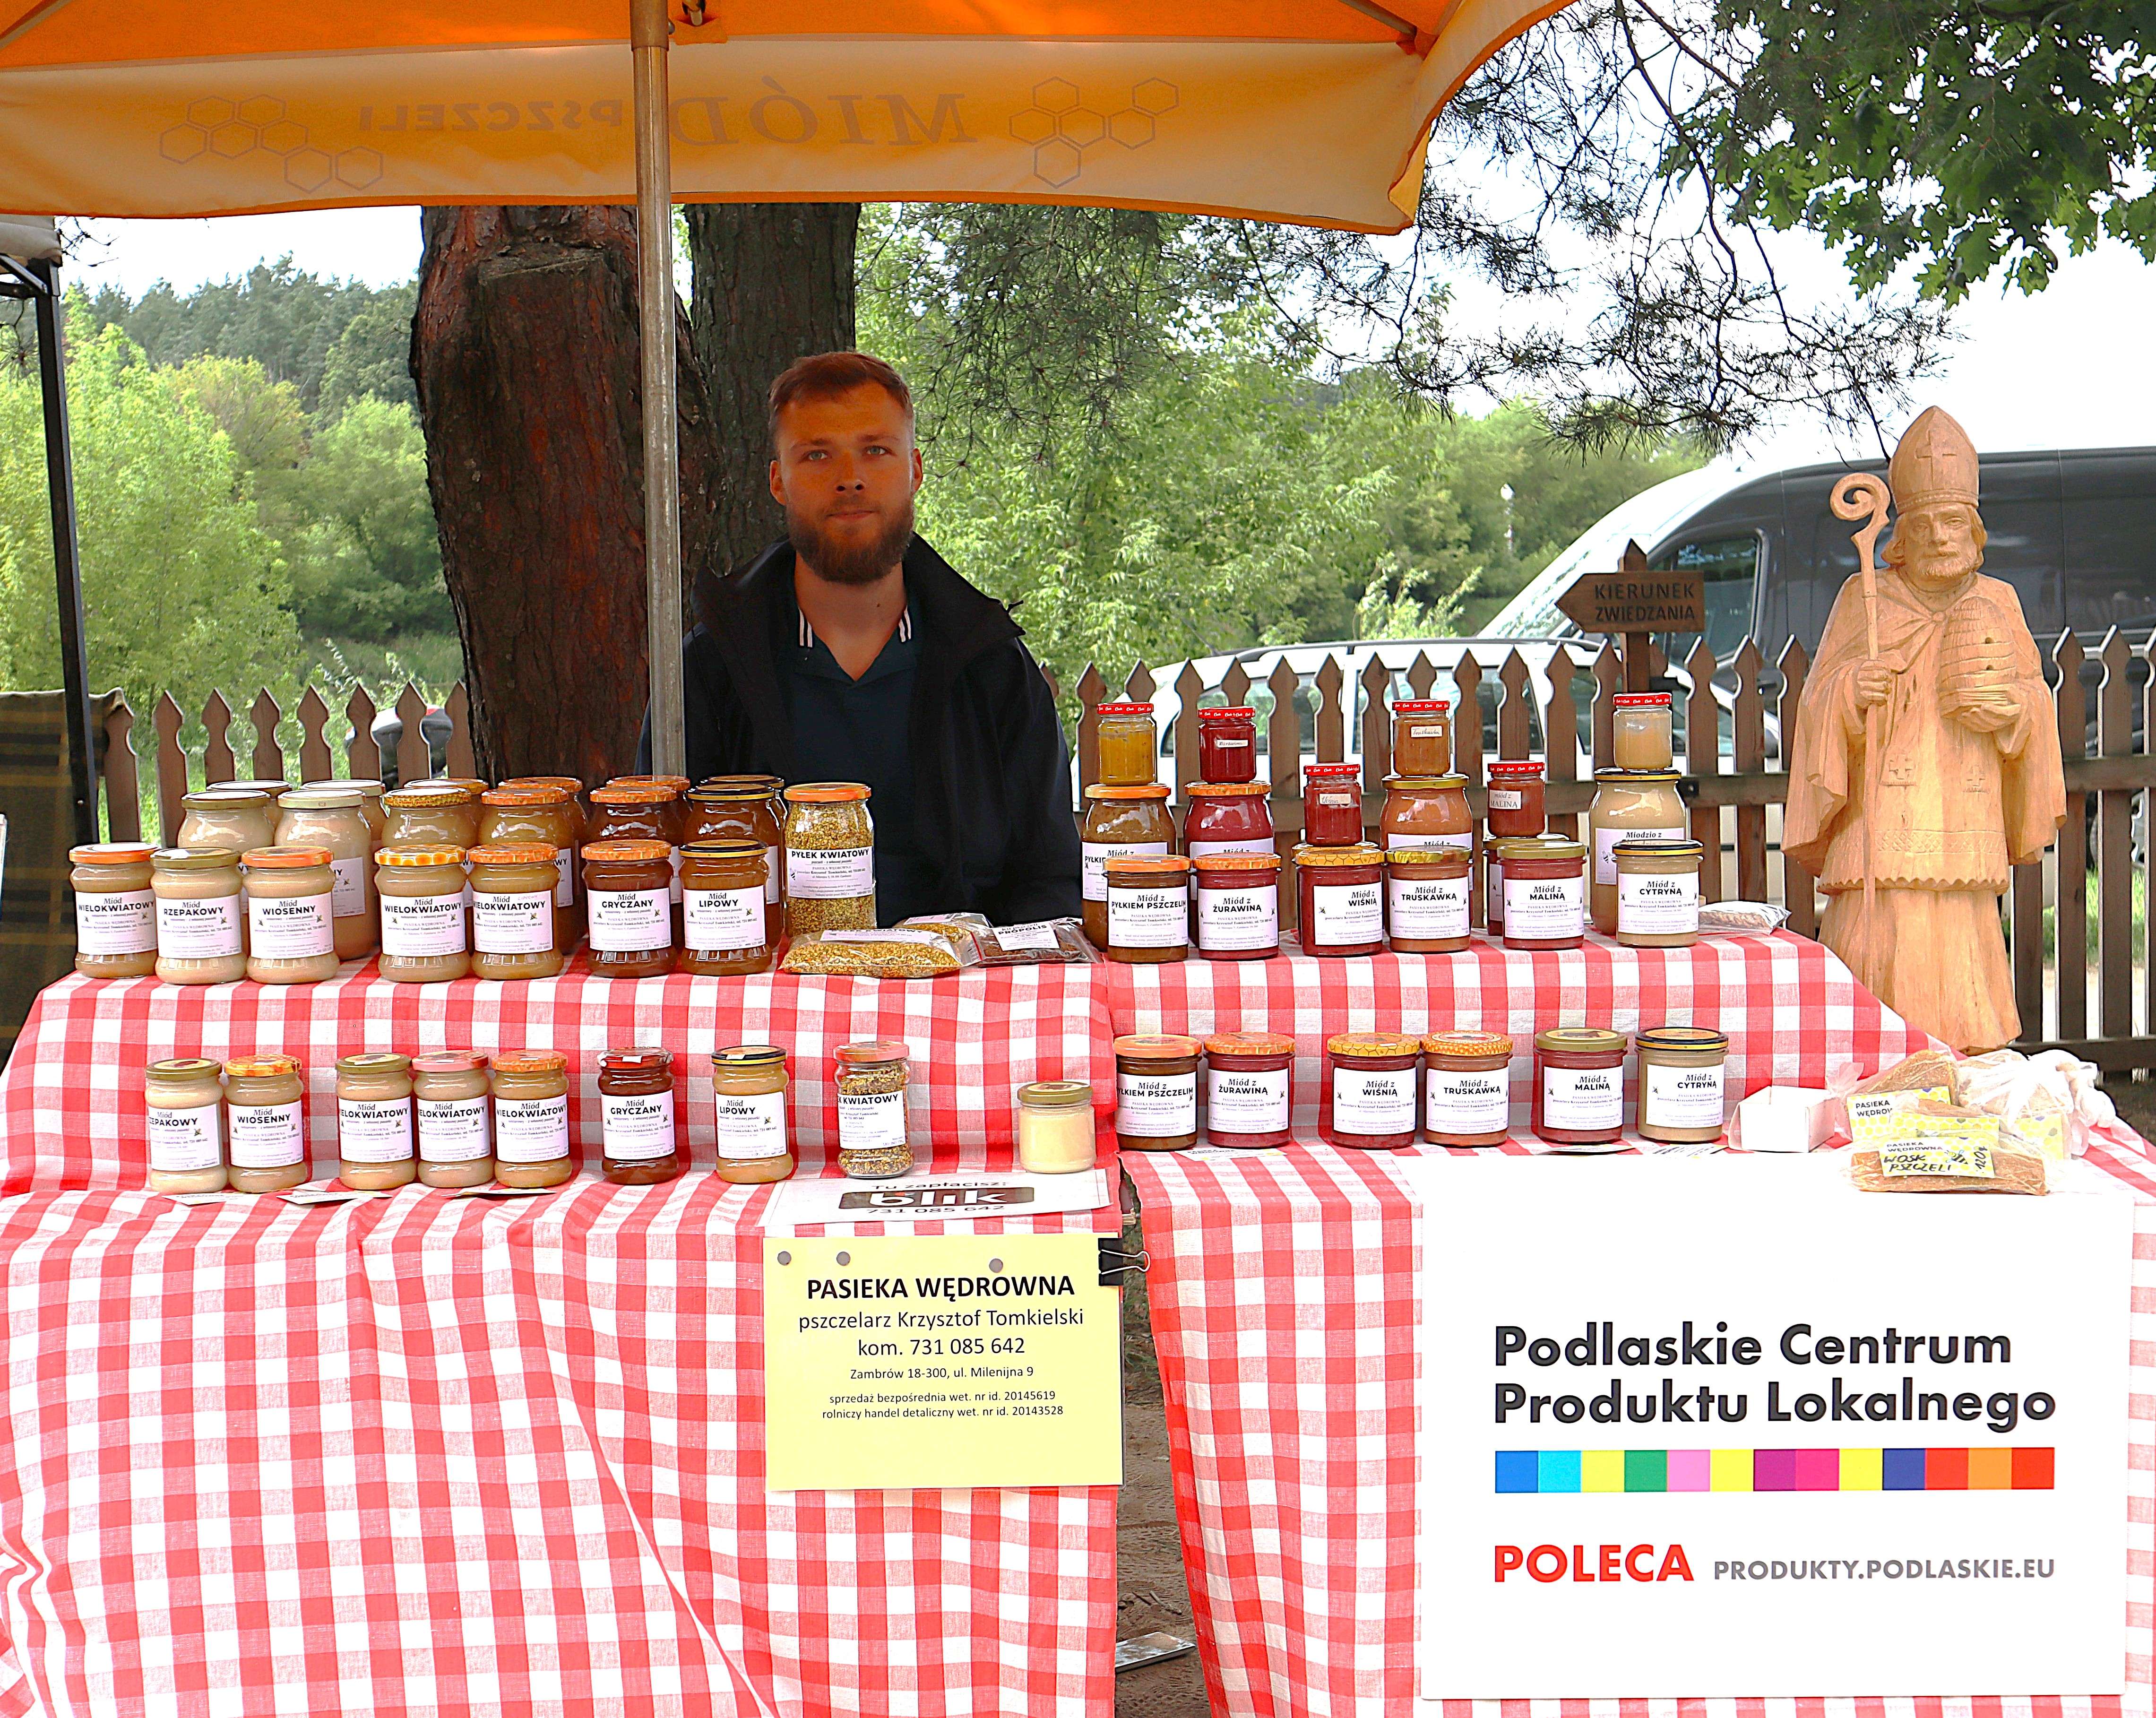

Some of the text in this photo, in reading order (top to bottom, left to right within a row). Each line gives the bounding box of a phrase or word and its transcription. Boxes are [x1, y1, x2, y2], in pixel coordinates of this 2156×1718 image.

[1595, 583, 1695, 599] KIERUNEK
[1595, 604, 1695, 622] ZWIEDZANIA
[792, 848, 869, 859] PYŁEK KWIATOWY
[1084, 855, 1106, 863] PYŁKIE
[1533, 885, 1555, 893] Miód
[1647, 881, 1668, 889] Miód
[1351, 890, 1371, 899] Miód
[1639, 888, 1682, 896] CYTRYNĄ
[1137, 894, 1158, 902] Miód
[1223, 897, 1244, 905] Miód
[1401, 893, 1457, 902] TRUSKAWKĄ
[1530, 893, 1565, 901] MALINĄ
[78, 900, 155, 912] WIELOKWIATOWY
[602, 899, 654, 908] GRYCZANY
[699, 899, 739, 907] LIPOWY
[1112, 901, 1144, 909] PYŁKIEM
[1348, 897, 1377, 907] WIŚNIĄ
[164, 906, 224, 916] RZEPAKOWY
[262, 905, 316, 915] WIOSENNY
[384, 902, 462, 914] WIELOKWIATOWY
[1213, 904, 1262, 913] ŻURAWINĄ
[998, 924, 1047, 935] PROPOLIS
[1579, 1075, 1601, 1083] Miód
[1686, 1073, 1707, 1081] Miód
[1228, 1078, 1249, 1086] Miód
[1677, 1080, 1717, 1088] CYTRYNĄ
[1218, 1084, 1268, 1095] ŻURAWINĄ
[1444, 1086, 1501, 1095] TRUSKAWKĄ
[1575, 1083, 1610, 1091] MALINĄ
[1117, 1088, 1145, 1097] YŁKIEM
[1362, 1088, 1398, 1097] WIŚNIĄ
[625, 1099, 645, 1107] Miód
[843, 1094, 898, 1105] KWIATOWY
[1856, 1100, 1890, 1109] PASIEKA
[610, 1105, 662, 1115] GRYCZANY
[720, 1107, 756, 1115] LIPOWY
[1856, 1108, 1893, 1117] WĘDROW
[237, 1114, 291, 1123] WIOSENNY
[1884, 1155, 1926, 1163] WOSK
[1889, 1163, 1951, 1172] PSZCZELI
[903, 1181, 1007, 1191] zapłacisz:
[869, 1190, 1008, 1206] blik
[808, 1276, 1075, 1302] PASIEKA WĘDROWNA
[799, 1308, 1083, 1333] pszczelarz Krzysztof Tomkielski
[858, 1337, 1025, 1356] kom. 731 085 642
[1494, 1321, 2012, 1367] Podlaskie Centrum
[850, 1366, 1034, 1381] Zambrów 18-300, ul. Milenijna 9
[829, 1392, 874, 1404] sprzedaż
[878, 1391, 946, 1405] bezpośrednia
[949, 1392, 971, 1402] wet.
[988, 1391, 1001, 1401] id.
[1004, 1390, 1056, 1400] 20145619
[1494, 1377, 2057, 1433] Produktu Lokalnego
[822, 1406, 1063, 1419] rolniczy handel detaliczny wet. nr id. 20143528
[1494, 1544, 2055, 1583] POLECA PRODUKTY.PODLASKIE.EU
